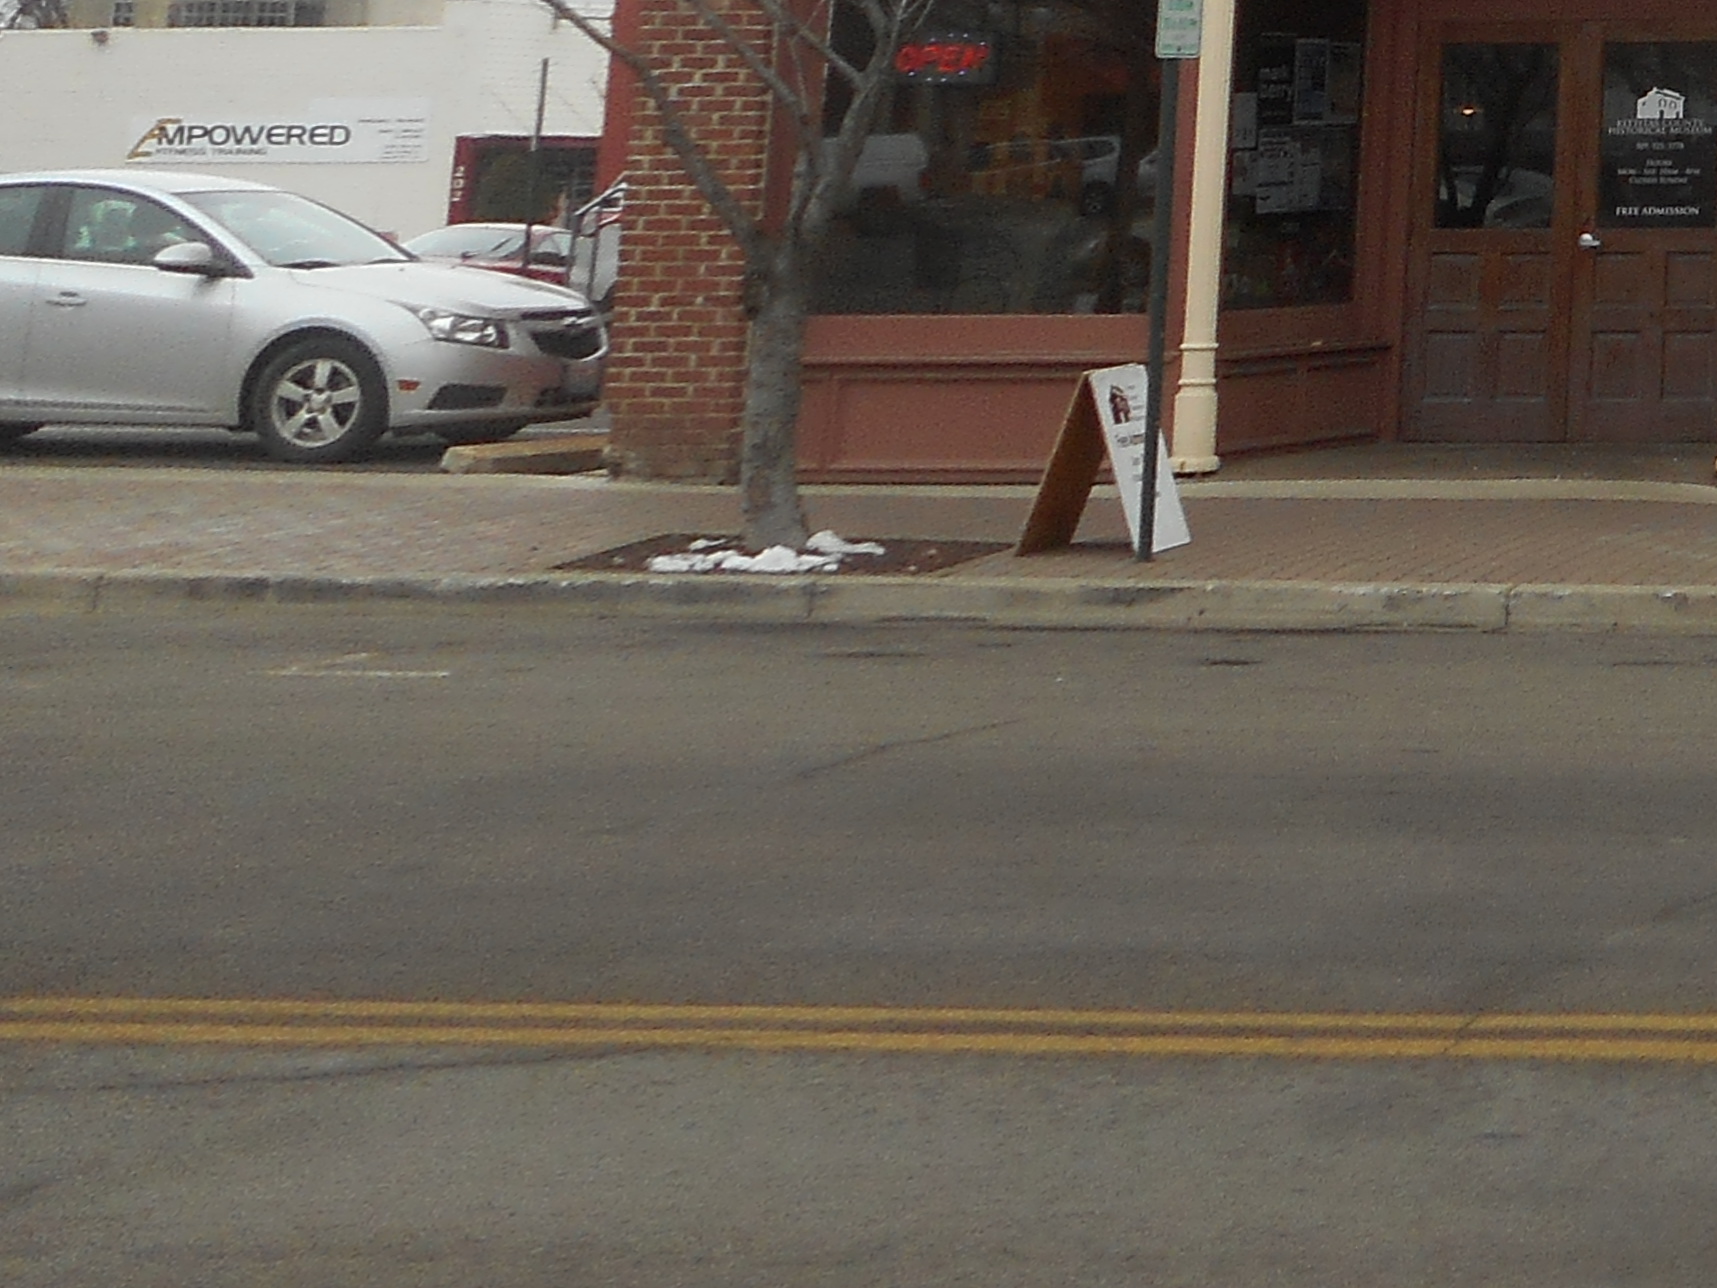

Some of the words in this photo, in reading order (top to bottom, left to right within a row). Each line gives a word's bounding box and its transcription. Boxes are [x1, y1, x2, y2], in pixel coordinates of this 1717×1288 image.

[895, 43, 989, 72] OPEN
[1616, 206, 1639, 216] FREE
[1641, 206, 1700, 216] ADMISSION
